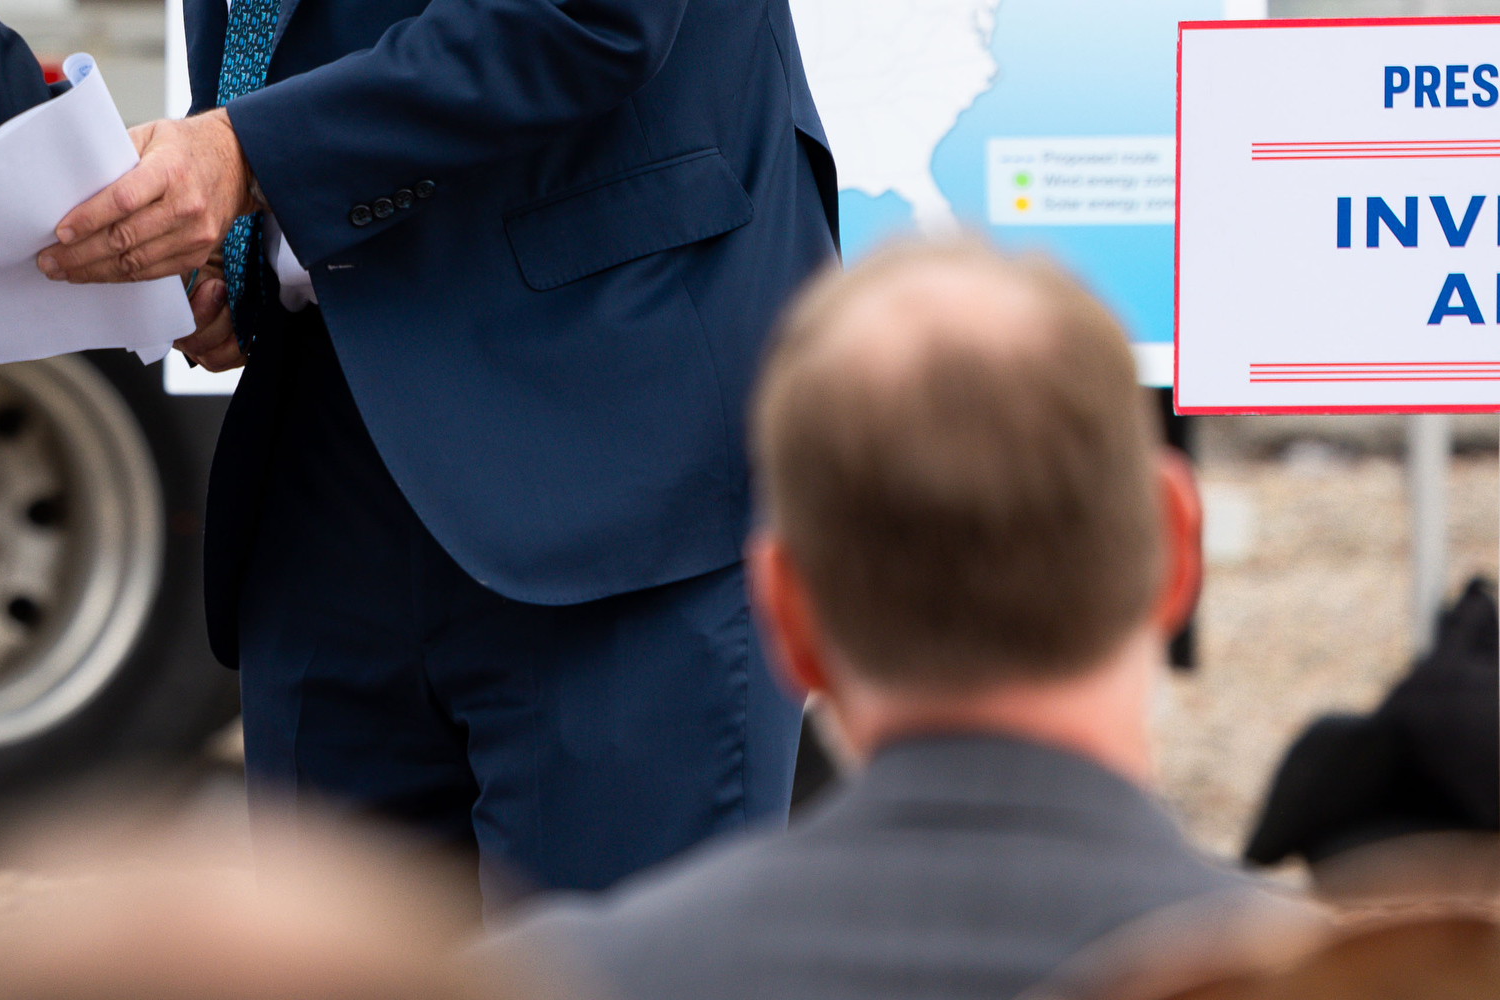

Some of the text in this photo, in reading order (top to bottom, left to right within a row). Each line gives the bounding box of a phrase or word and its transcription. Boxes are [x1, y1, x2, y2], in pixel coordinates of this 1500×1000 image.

[1384, 63, 1499, 109] PRES
[1337, 195, 1500, 248] INV
[1427, 273, 1500, 325] A
